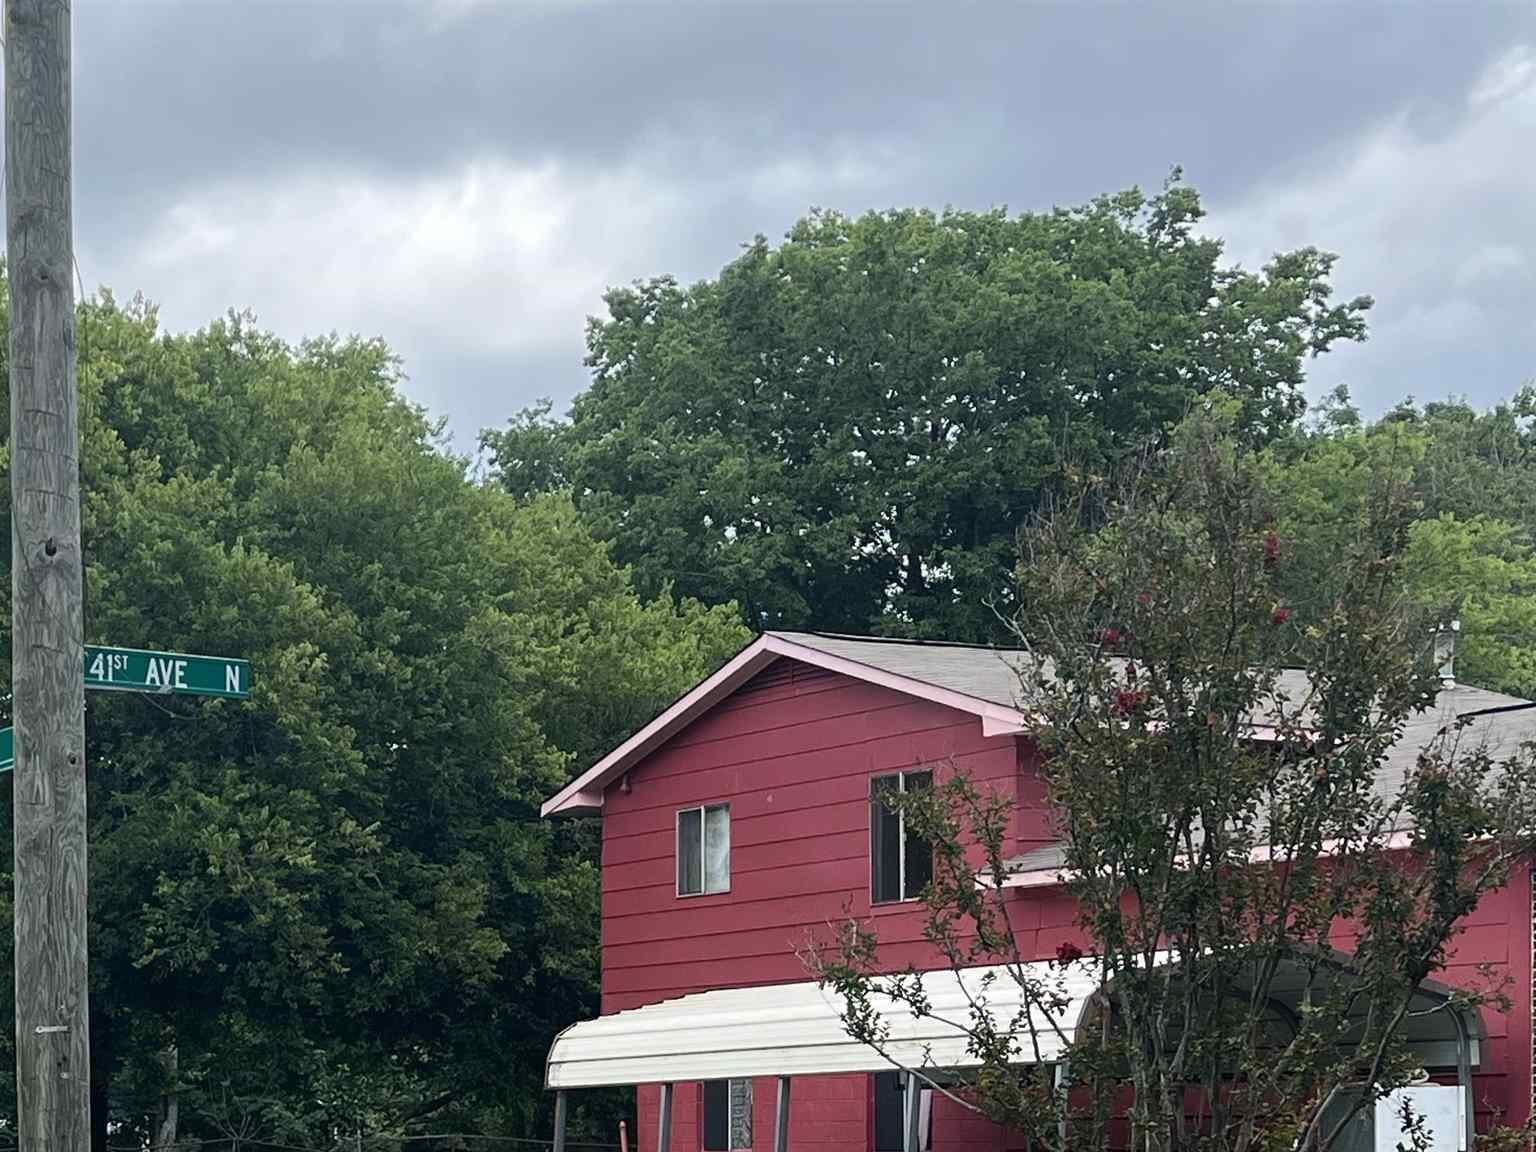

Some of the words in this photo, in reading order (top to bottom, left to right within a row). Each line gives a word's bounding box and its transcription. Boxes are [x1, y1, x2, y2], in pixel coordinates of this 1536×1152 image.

[89, 654, 129, 683] 41ST
[145, 658, 188, 689] AVE
[225, 664, 241, 693] N
